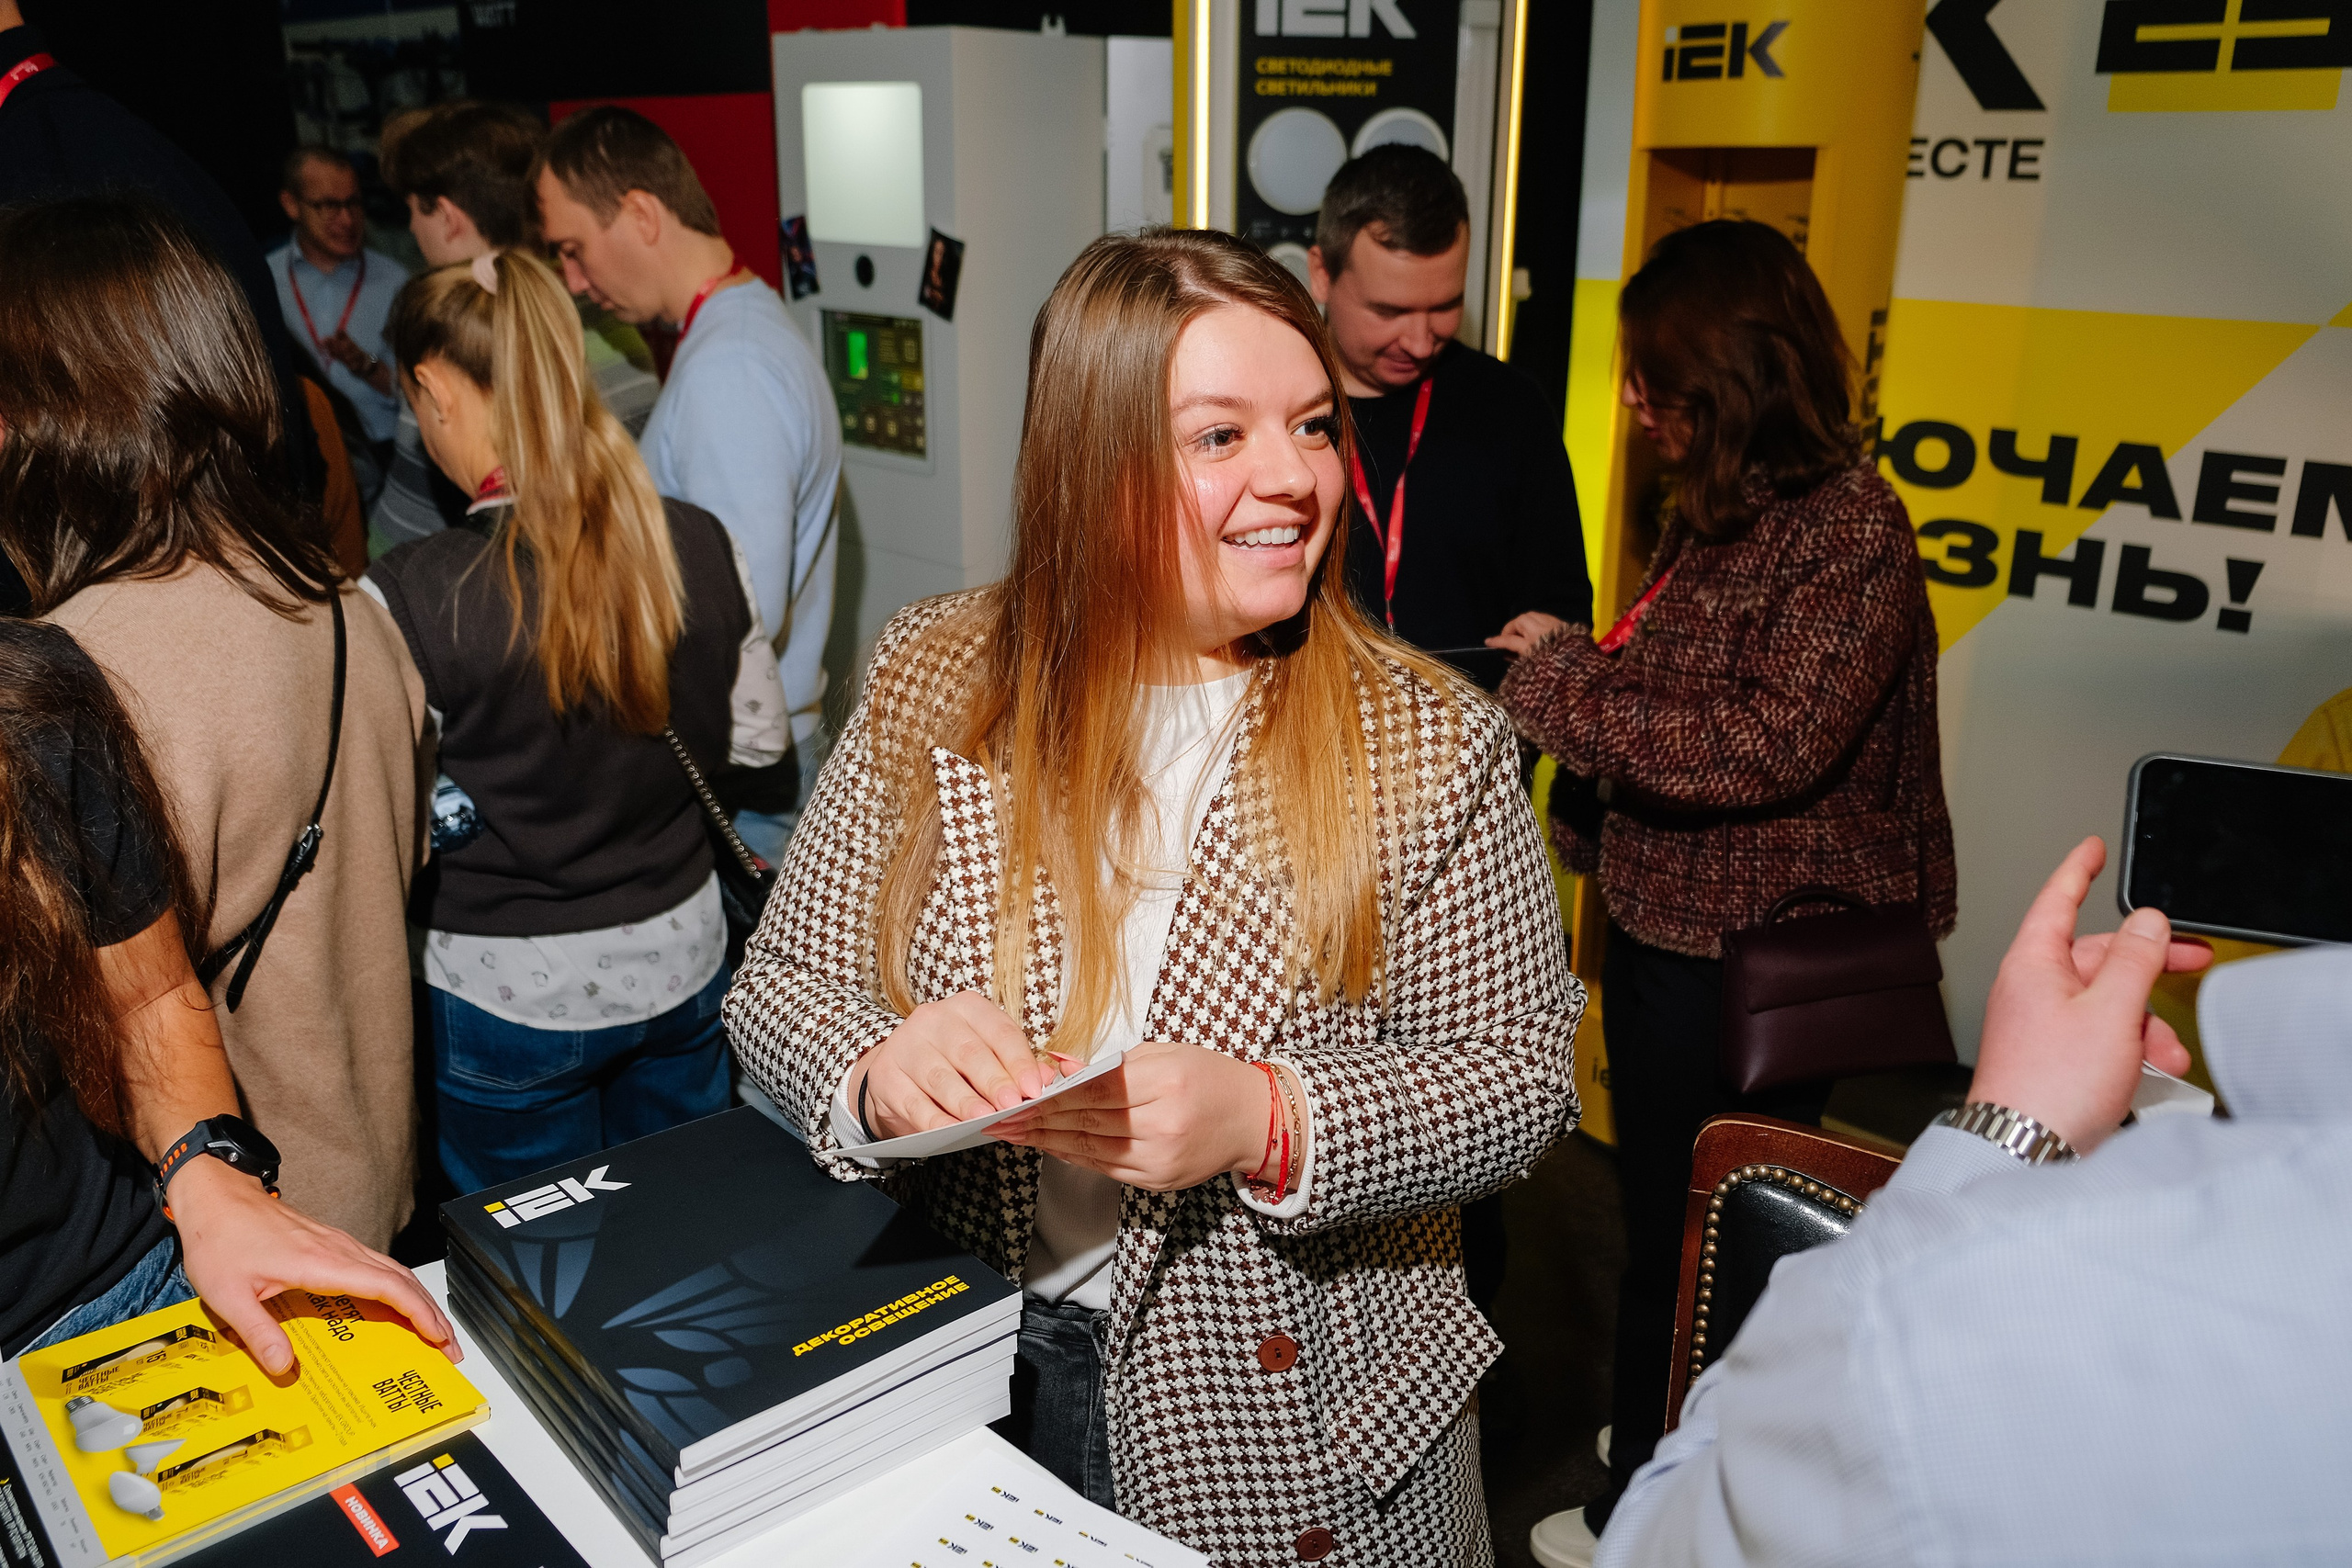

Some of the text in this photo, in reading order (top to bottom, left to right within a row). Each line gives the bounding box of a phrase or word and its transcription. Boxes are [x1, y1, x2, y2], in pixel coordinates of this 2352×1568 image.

[1254, 77, 1377, 97] СВЕТИЛЬНИКИ
[1255, 56, 1394, 78] СВЕТОДИОДНЫЕ
[322, 1310, 355, 1342] надо
[792, 1274, 961, 1357] ДЕКОРАТИВНОЕ
[838, 1281, 970, 1346] ОСВЕЩЕНИЕ
[372, 1378, 413, 1413] ВАТТЫ
[397, 1369, 443, 1414] ЧЕСТНЫЕ
[345, 1495, 390, 1551] НОВИНКА
